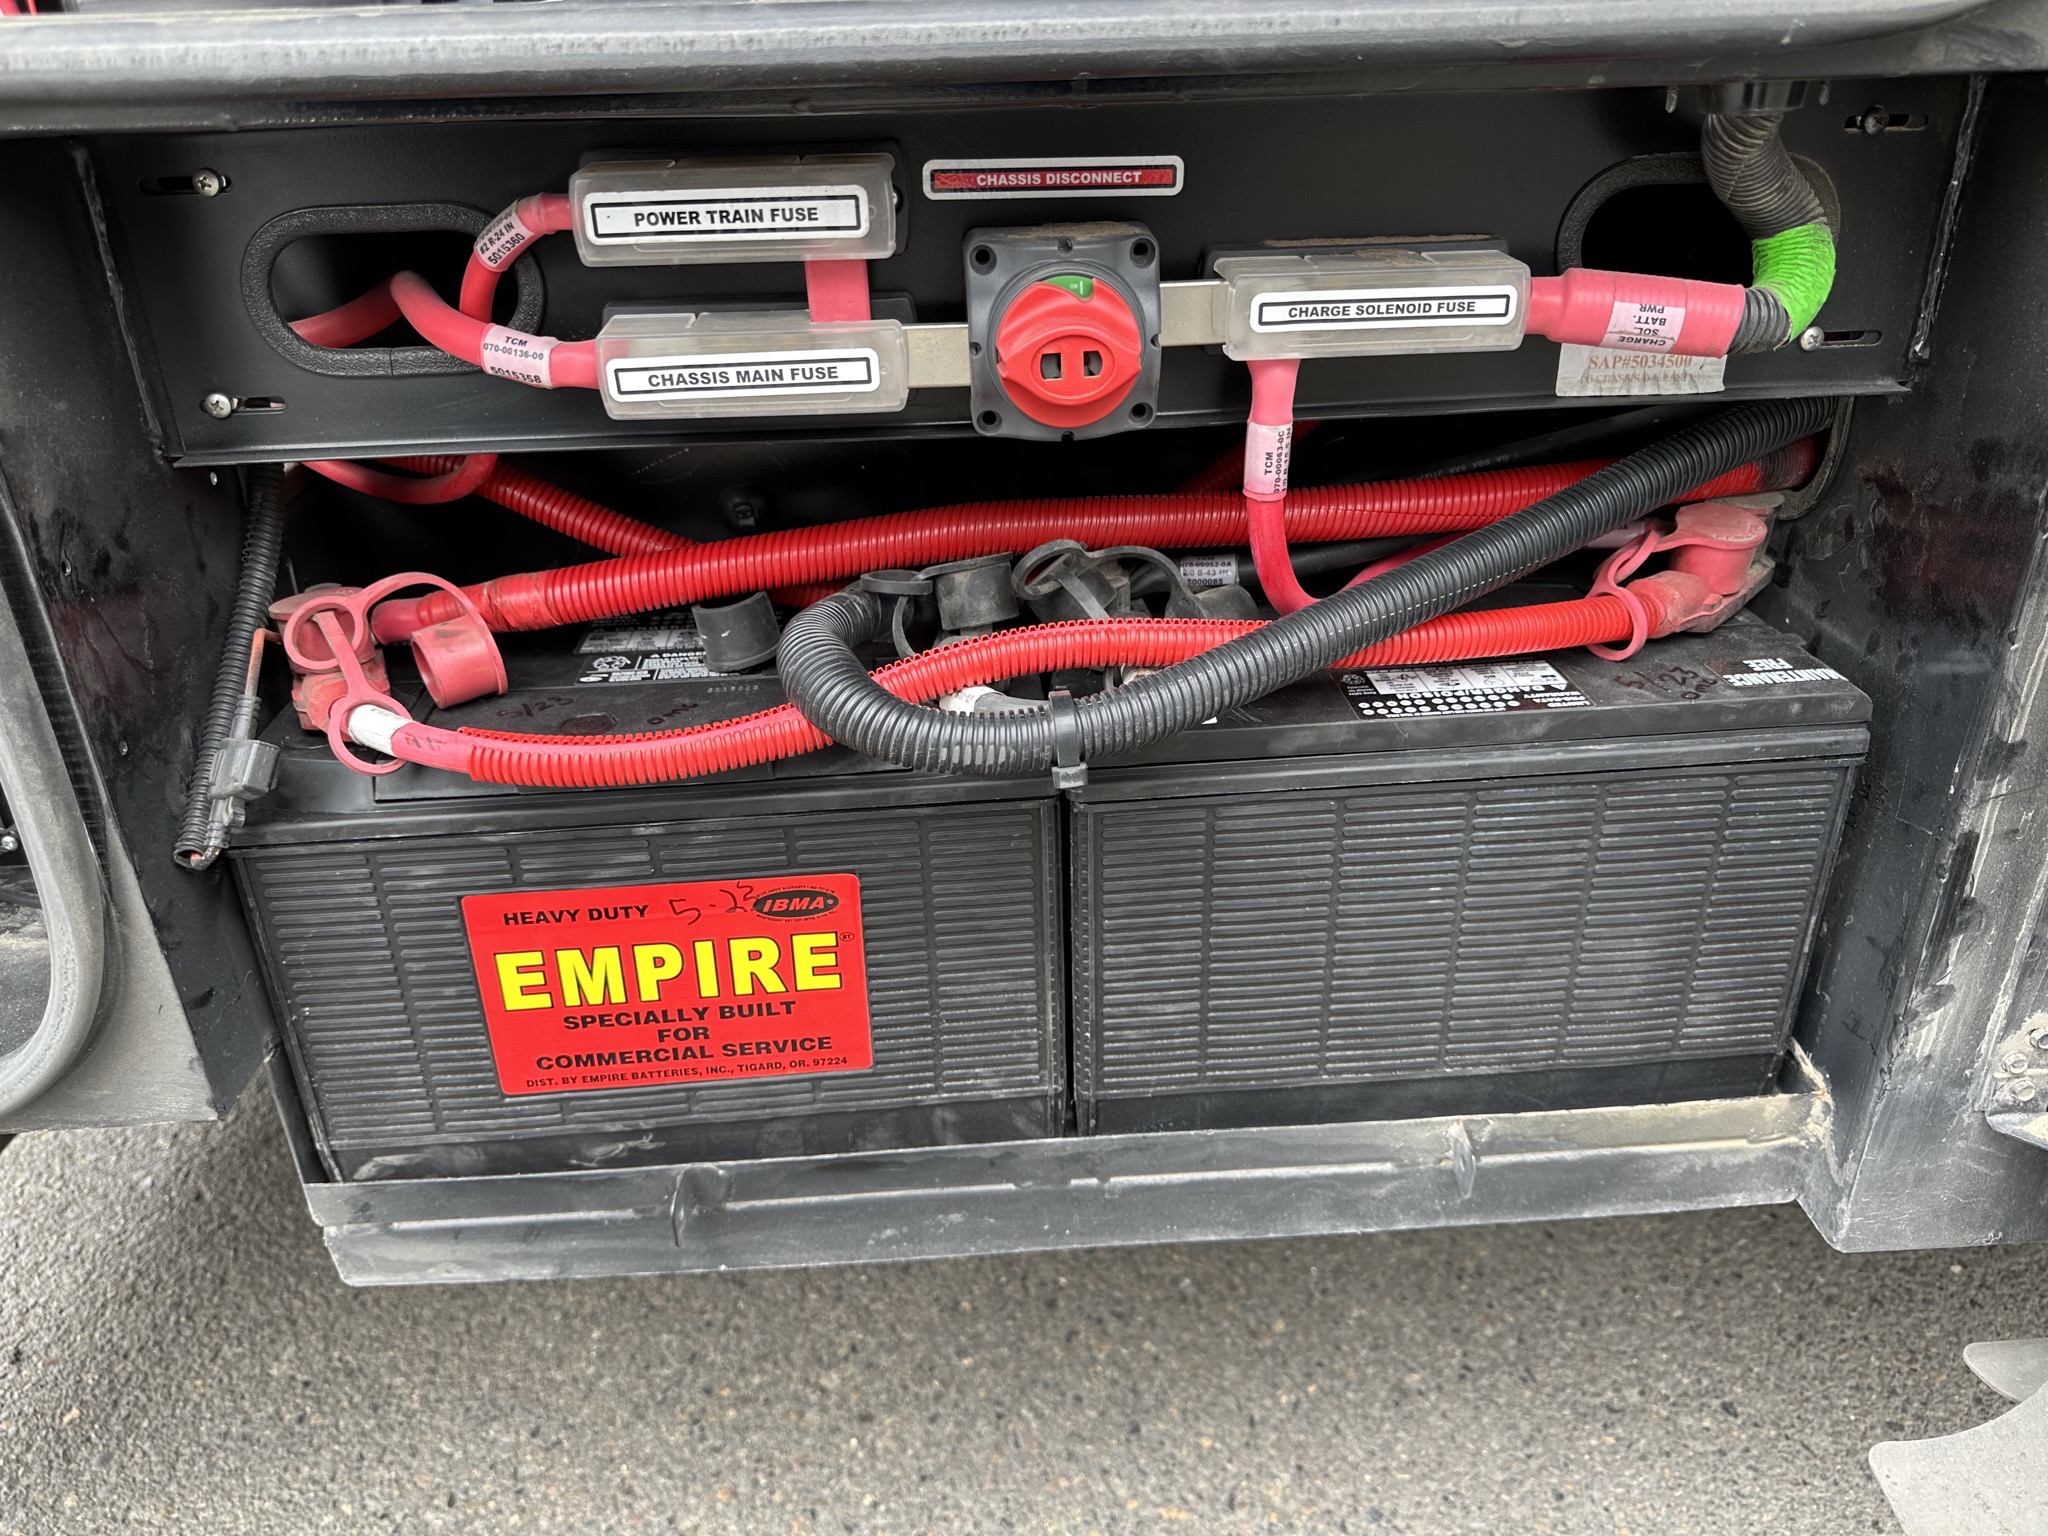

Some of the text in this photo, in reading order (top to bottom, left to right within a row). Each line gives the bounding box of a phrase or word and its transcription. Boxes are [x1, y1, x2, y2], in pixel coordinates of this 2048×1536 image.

[976, 172, 1142, 186] CHASSIS DISCONNECT
[634, 206, 819, 228] POWER TRAIN FUSE
[488, 227, 506, 246] R-24
[503, 220, 515, 235] IN
[487, 232, 526, 264] 5015360
[1288, 302, 1476, 318] CHARGE SOLENOID FUSE
[1639, 303, 1665, 314] PWR
[1633, 315, 1667, 326] BATT.
[1633, 326, 1660, 336] SOL.
[505, 336, 528, 347] TCM
[1617, 335, 1666, 347] CHARGE
[483, 342, 544, 361] 070-00136-00
[1589, 354, 1693, 370] SAP#5034500
[490, 366, 542, 384] 5015358
[648, 366, 840, 389] CHASSIS MAIN FUSE
[1264, 452, 1274, 476] TCM
[1187, 578, 1224, 586] 5000085
[1742, 657, 1794, 672] FREE
[1722, 668, 1850, 687] MAINTENANCE
[669, 880, 760, 926] 5-23
[762, 896, 825, 913] IBMA
[503, 904, 650, 926] HEAVY DUTY
[494, 931, 840, 1011] EMPIRE
[563, 1000, 796, 1030] SPECIALLY BUILT
[658, 1026, 710, 1043] FOR
[536, 1036, 833, 1070] COMMERCIAL SERVICE
[526, 1057, 848, 1088] DIST. BY EMPIRE BATTERIES, INC., TIGARD, OR. 97224
